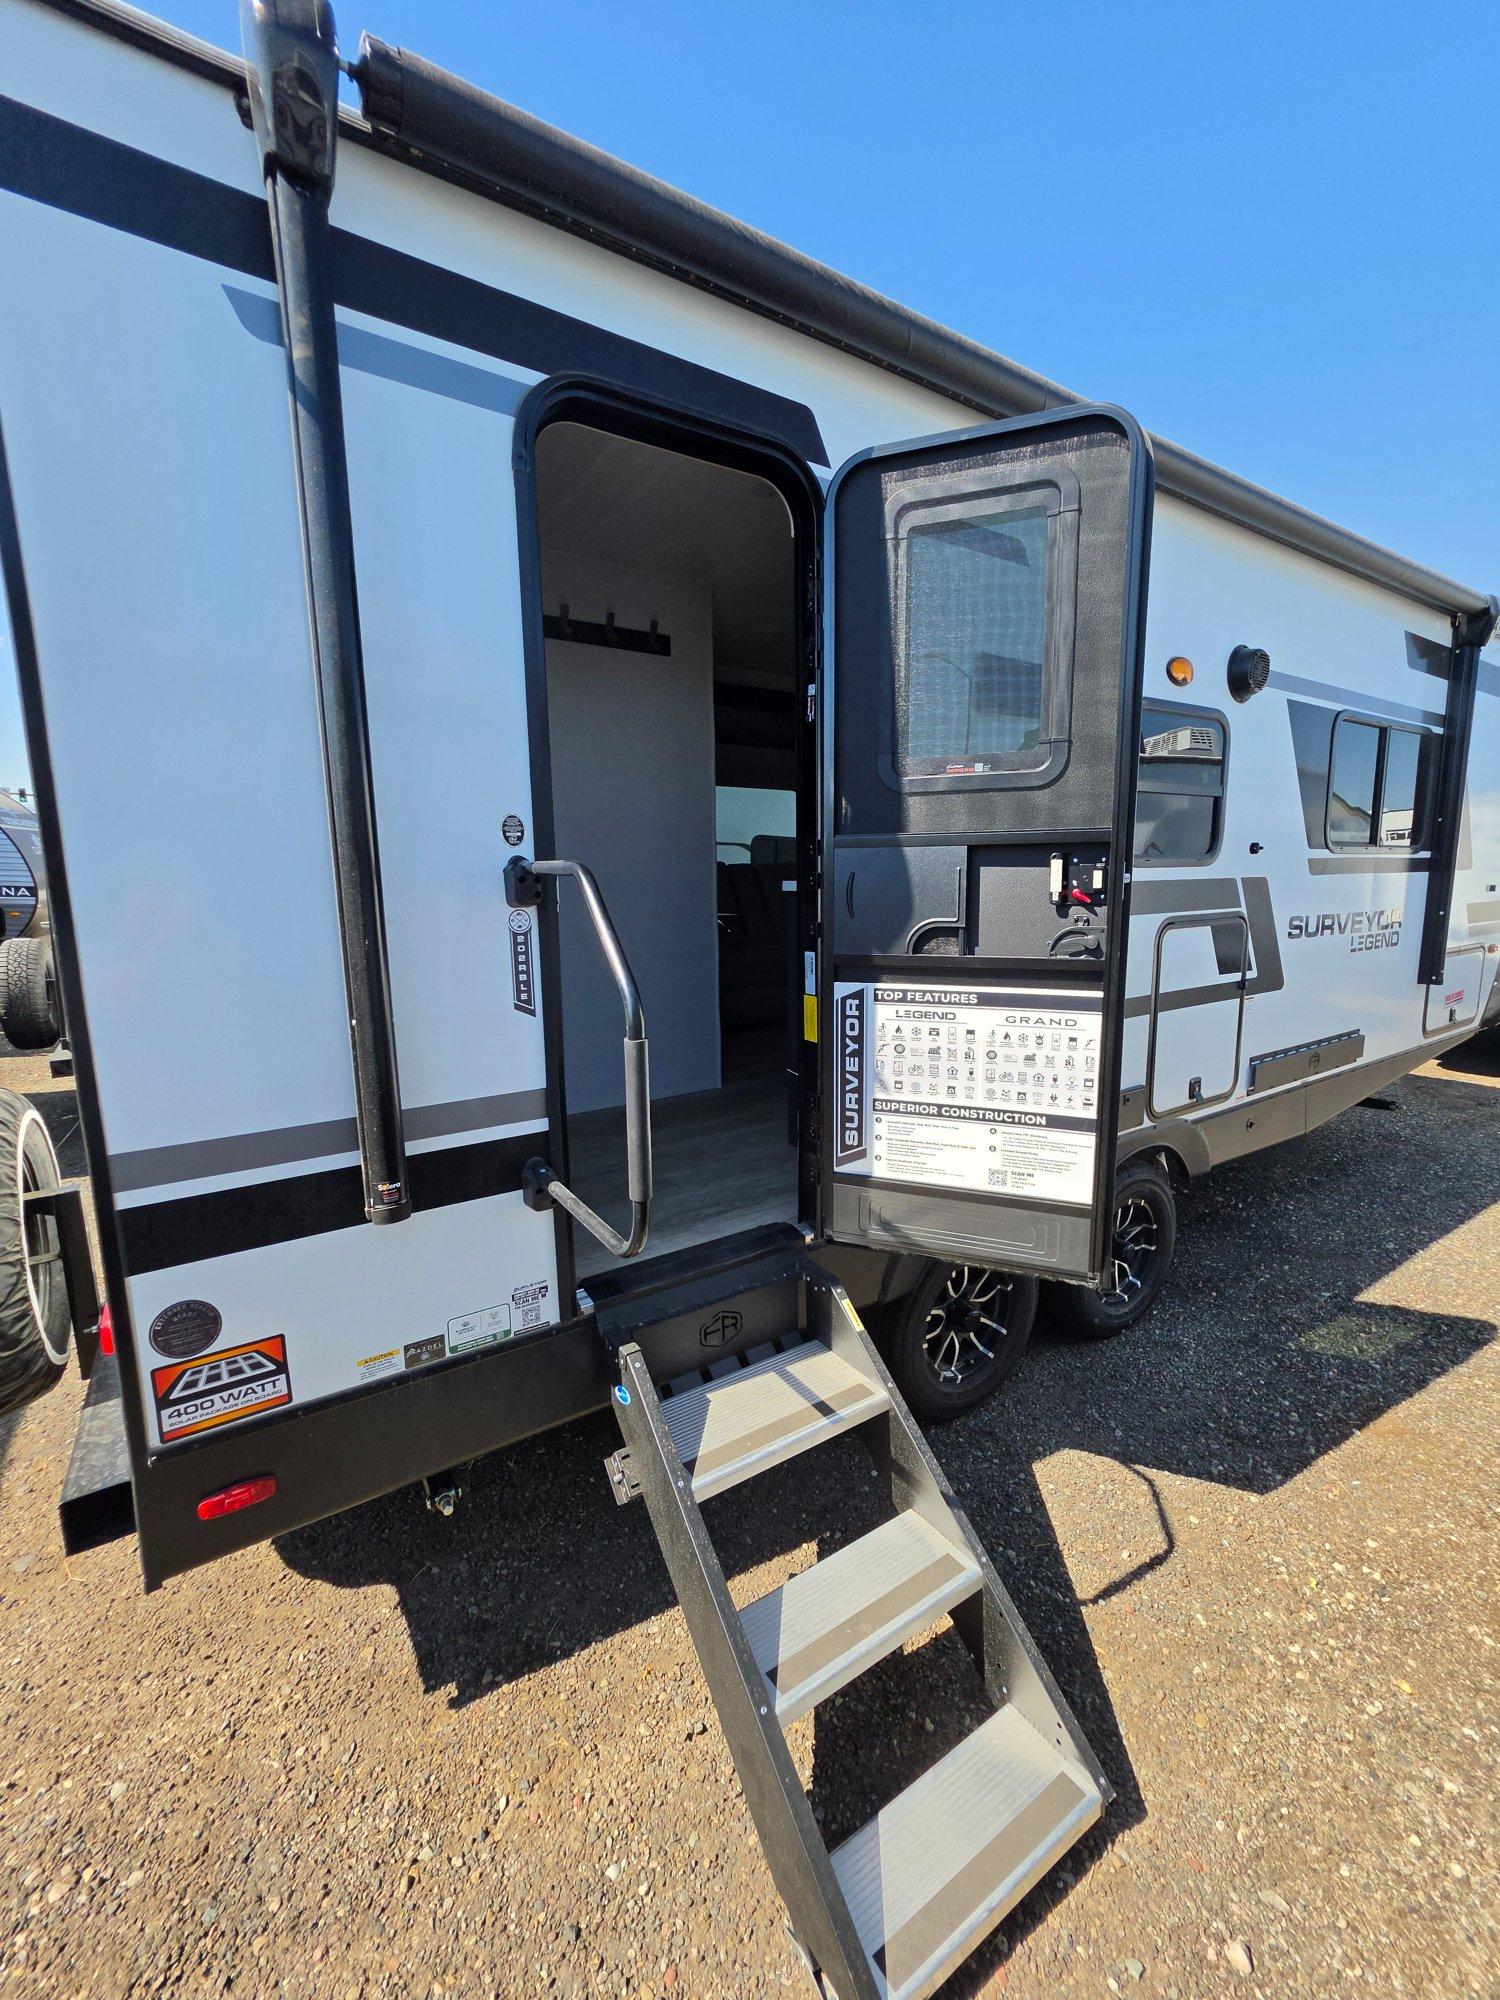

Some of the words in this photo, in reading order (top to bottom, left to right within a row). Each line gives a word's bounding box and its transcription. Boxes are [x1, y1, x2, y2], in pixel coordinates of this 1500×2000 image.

[1288, 908, 1402, 939] SURVEYOR
[1350, 931, 1400, 953] LEGEND
[875, 990, 903, 1001] TOP
[907, 992, 978, 1004] FEATURES
[895, 1009, 957, 1020] LEGEND
[1005, 1015, 1078, 1027] GRAND
[845, 998, 860, 1146] SURVEYOR
[874, 1101, 938, 1115] SUPERIOR
[941, 1106, 1047, 1126] CONSTRUCTION
[514, 1298, 530, 1307] SCAN
[368, 1351, 394, 1363] CAUTION
[168, 1398, 215, 1420] 400
[219, 1378, 281, 1405] WATT
[168, 1415, 198, 1428] SOLAR
[199, 1403, 240, 1416] PACKAGE
[240, 1397, 253, 1406] ON
[254, 1389, 283, 1402] BOARD
